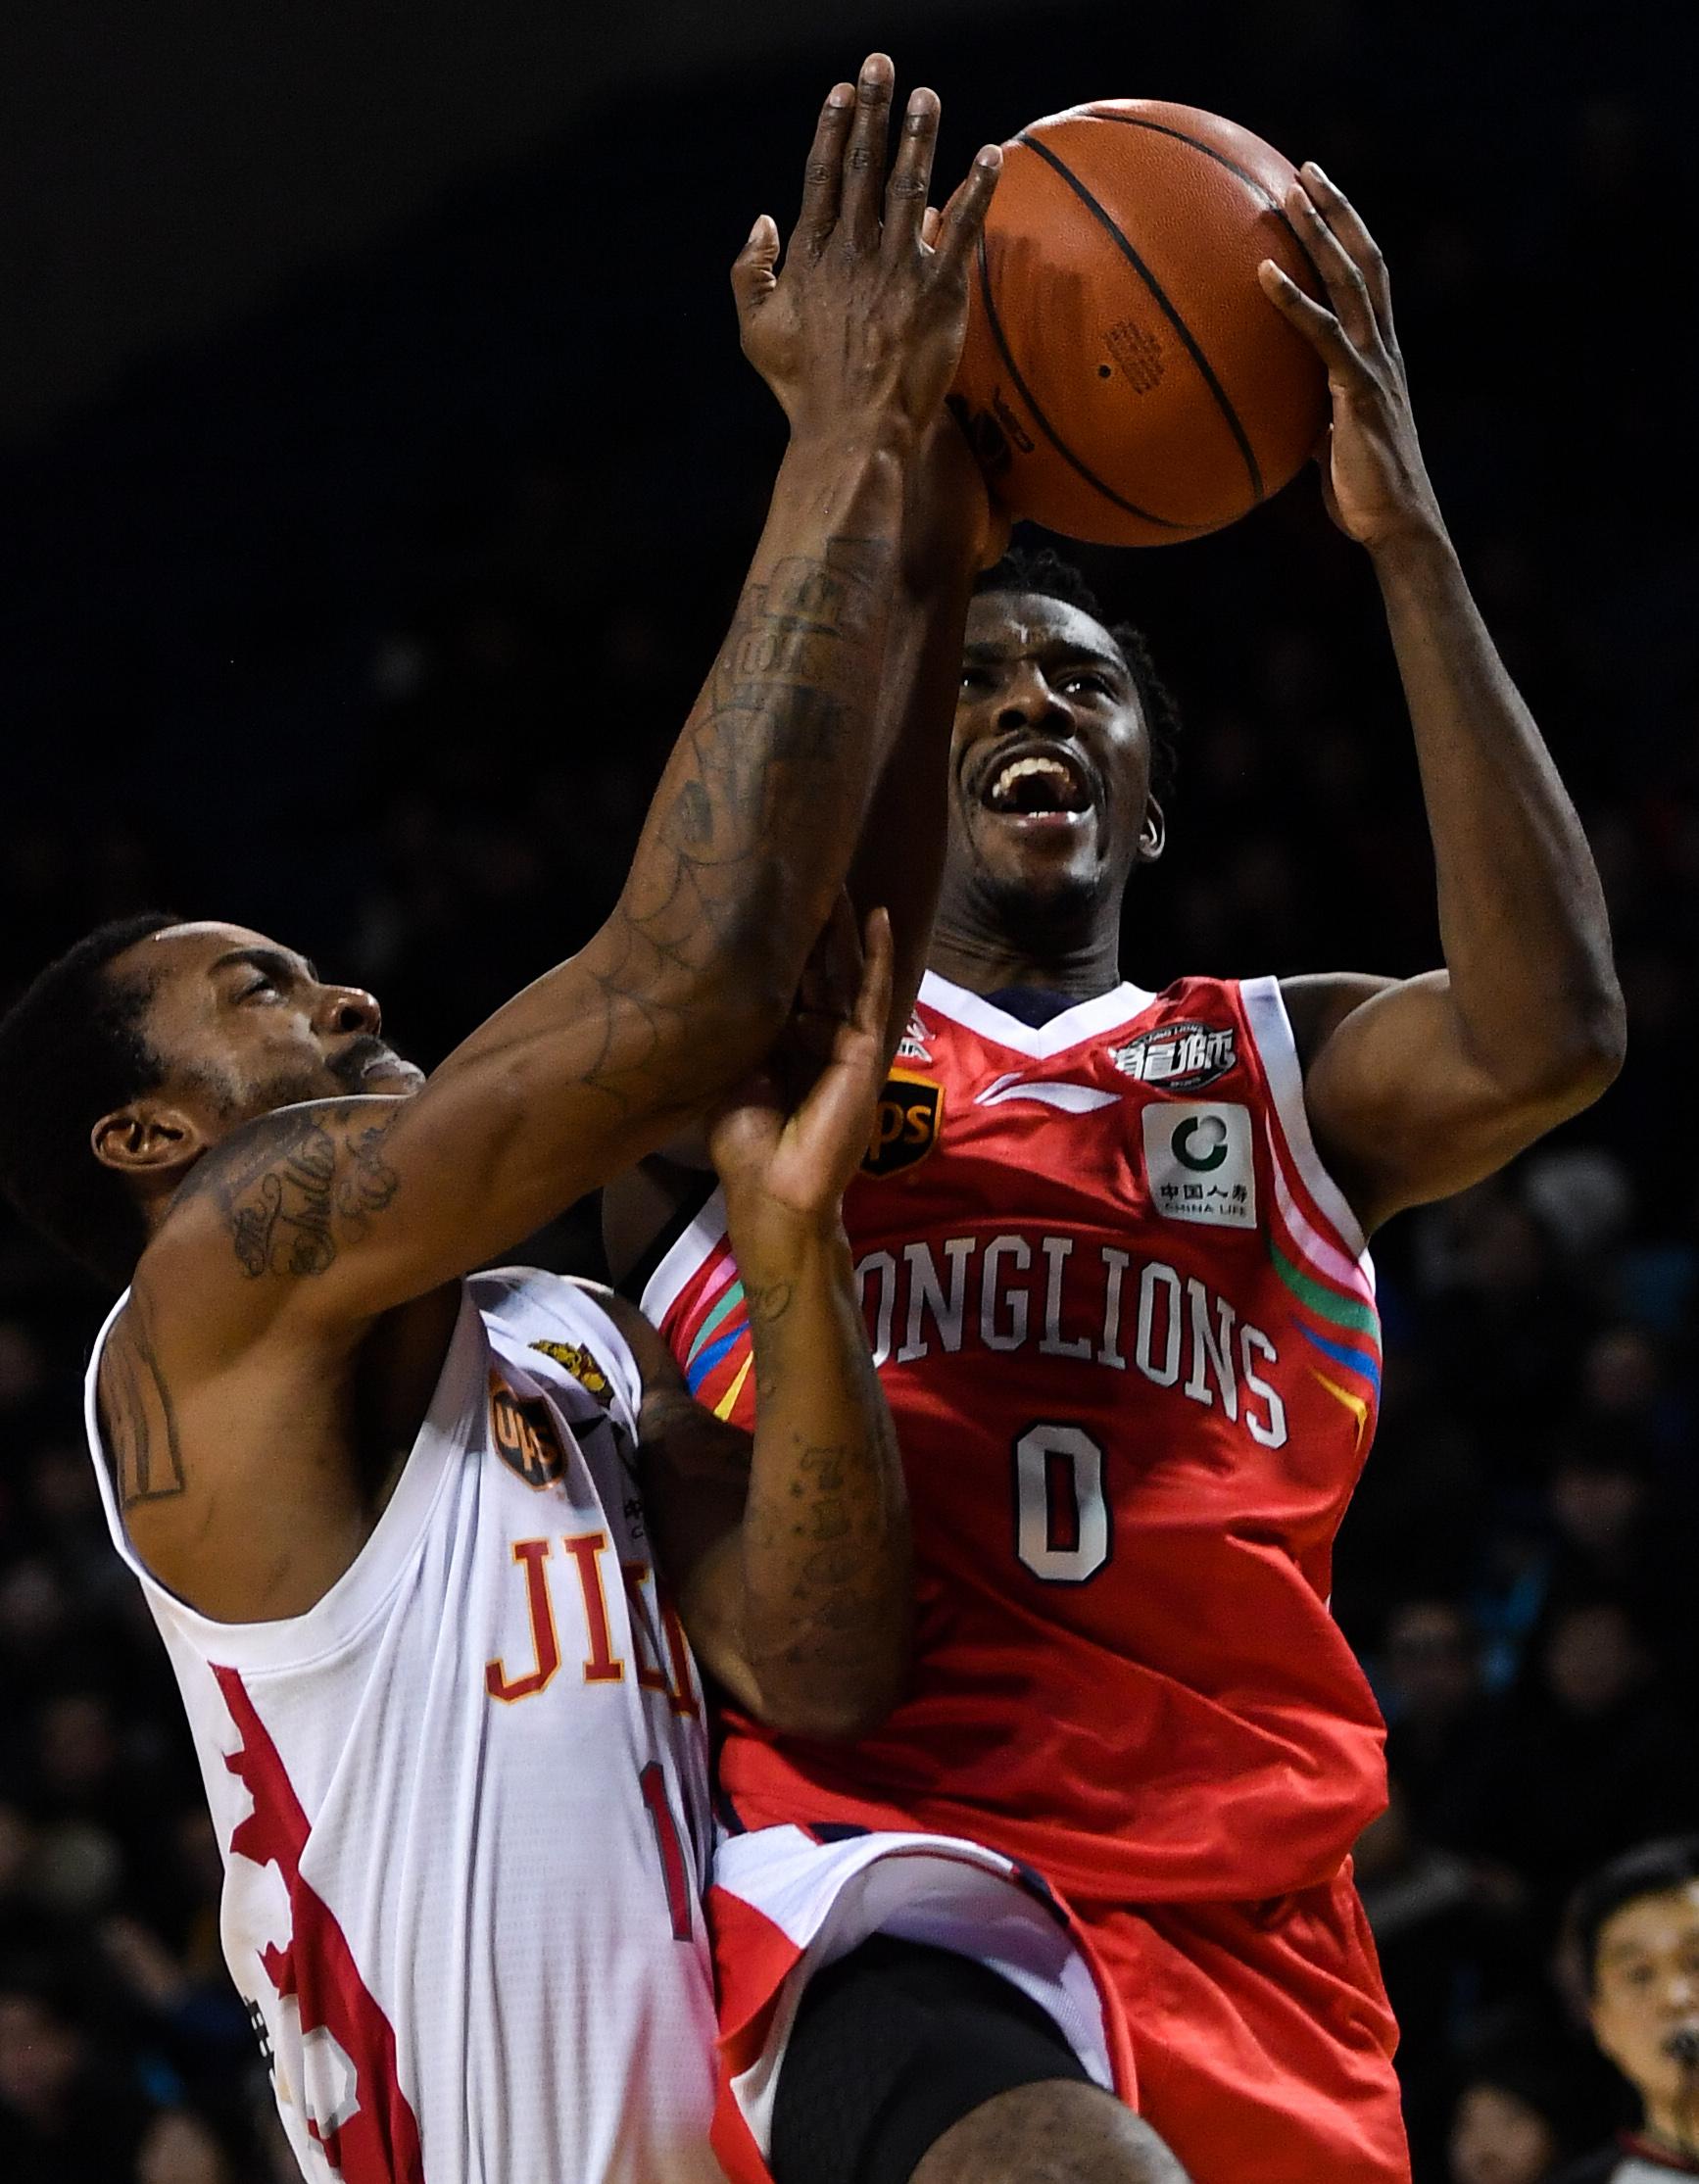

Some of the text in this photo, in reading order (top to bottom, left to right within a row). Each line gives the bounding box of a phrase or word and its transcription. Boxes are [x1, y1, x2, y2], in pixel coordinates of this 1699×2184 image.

[1159, 1183, 1247, 1203] 中国人寿
[1164, 1202, 1215, 1214] CHINA
[854, 1234, 1288, 1449] ONGLIONS
[1014, 1421, 1111, 1584] 0
